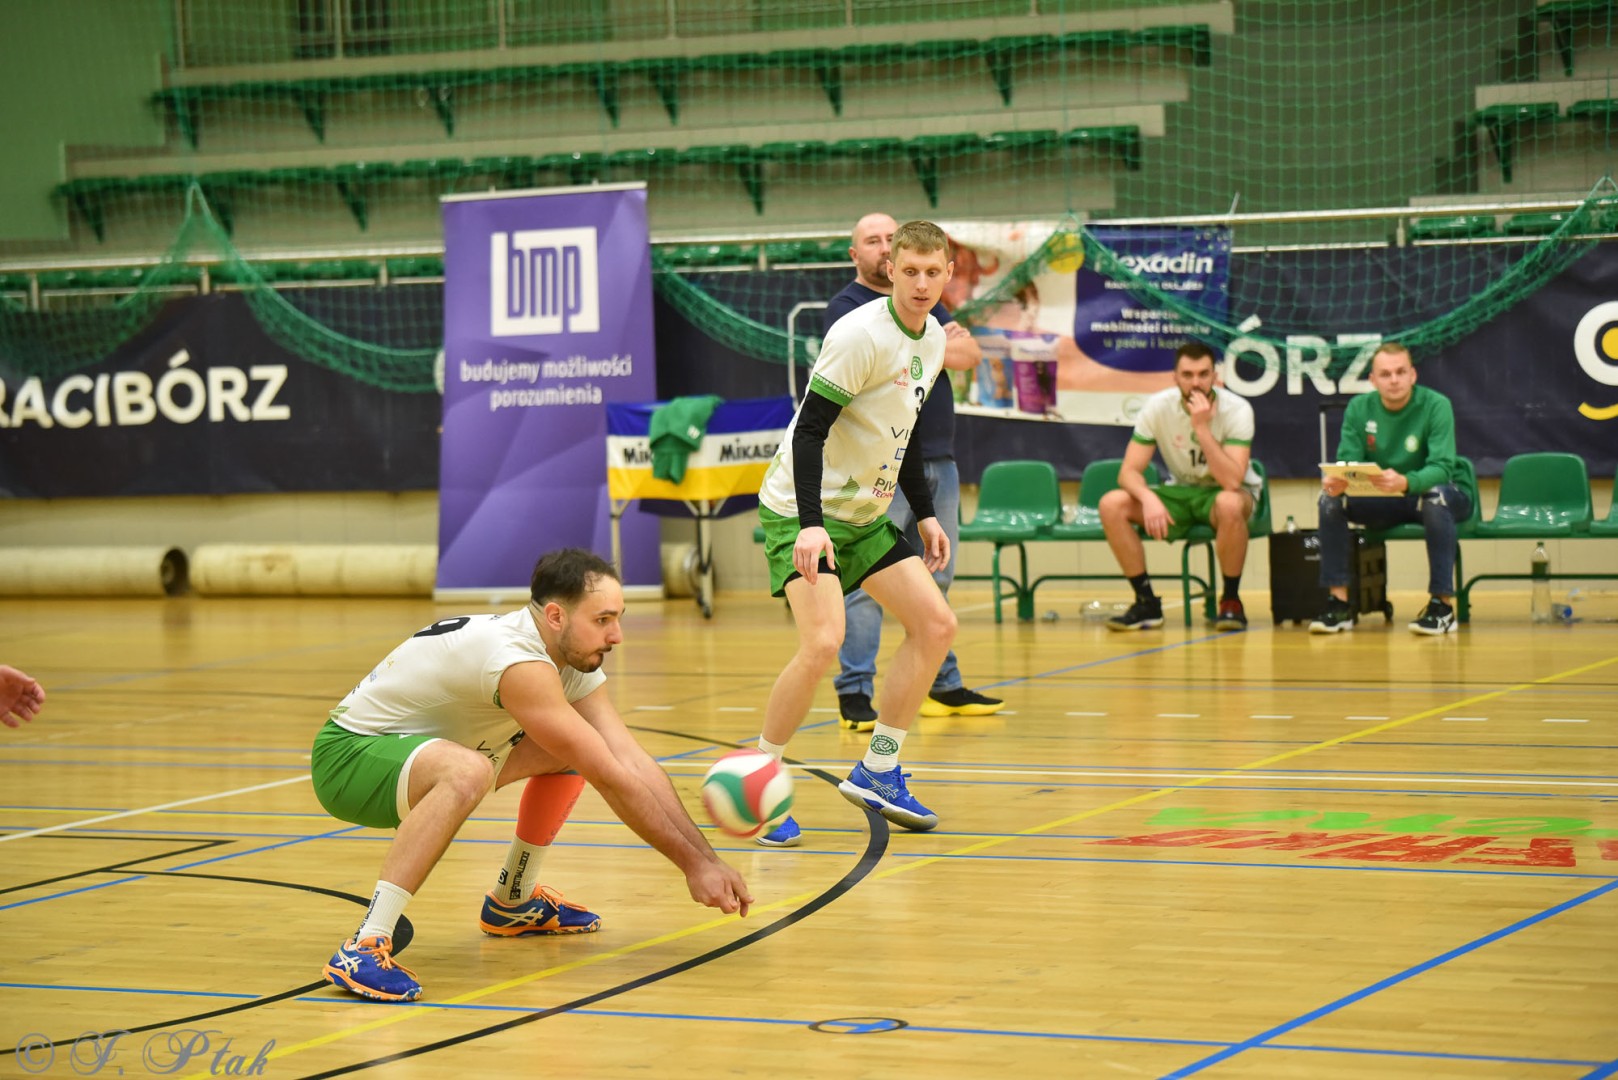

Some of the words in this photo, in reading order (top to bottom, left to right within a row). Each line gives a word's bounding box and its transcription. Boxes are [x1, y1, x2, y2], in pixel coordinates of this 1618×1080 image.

[502, 230, 588, 335] bmp
[460, 358, 540, 385] budujemy
[541, 353, 632, 379] możliwości
[1216, 313, 1383, 398] ÓRZ
[490, 382, 603, 412] porozumienia
